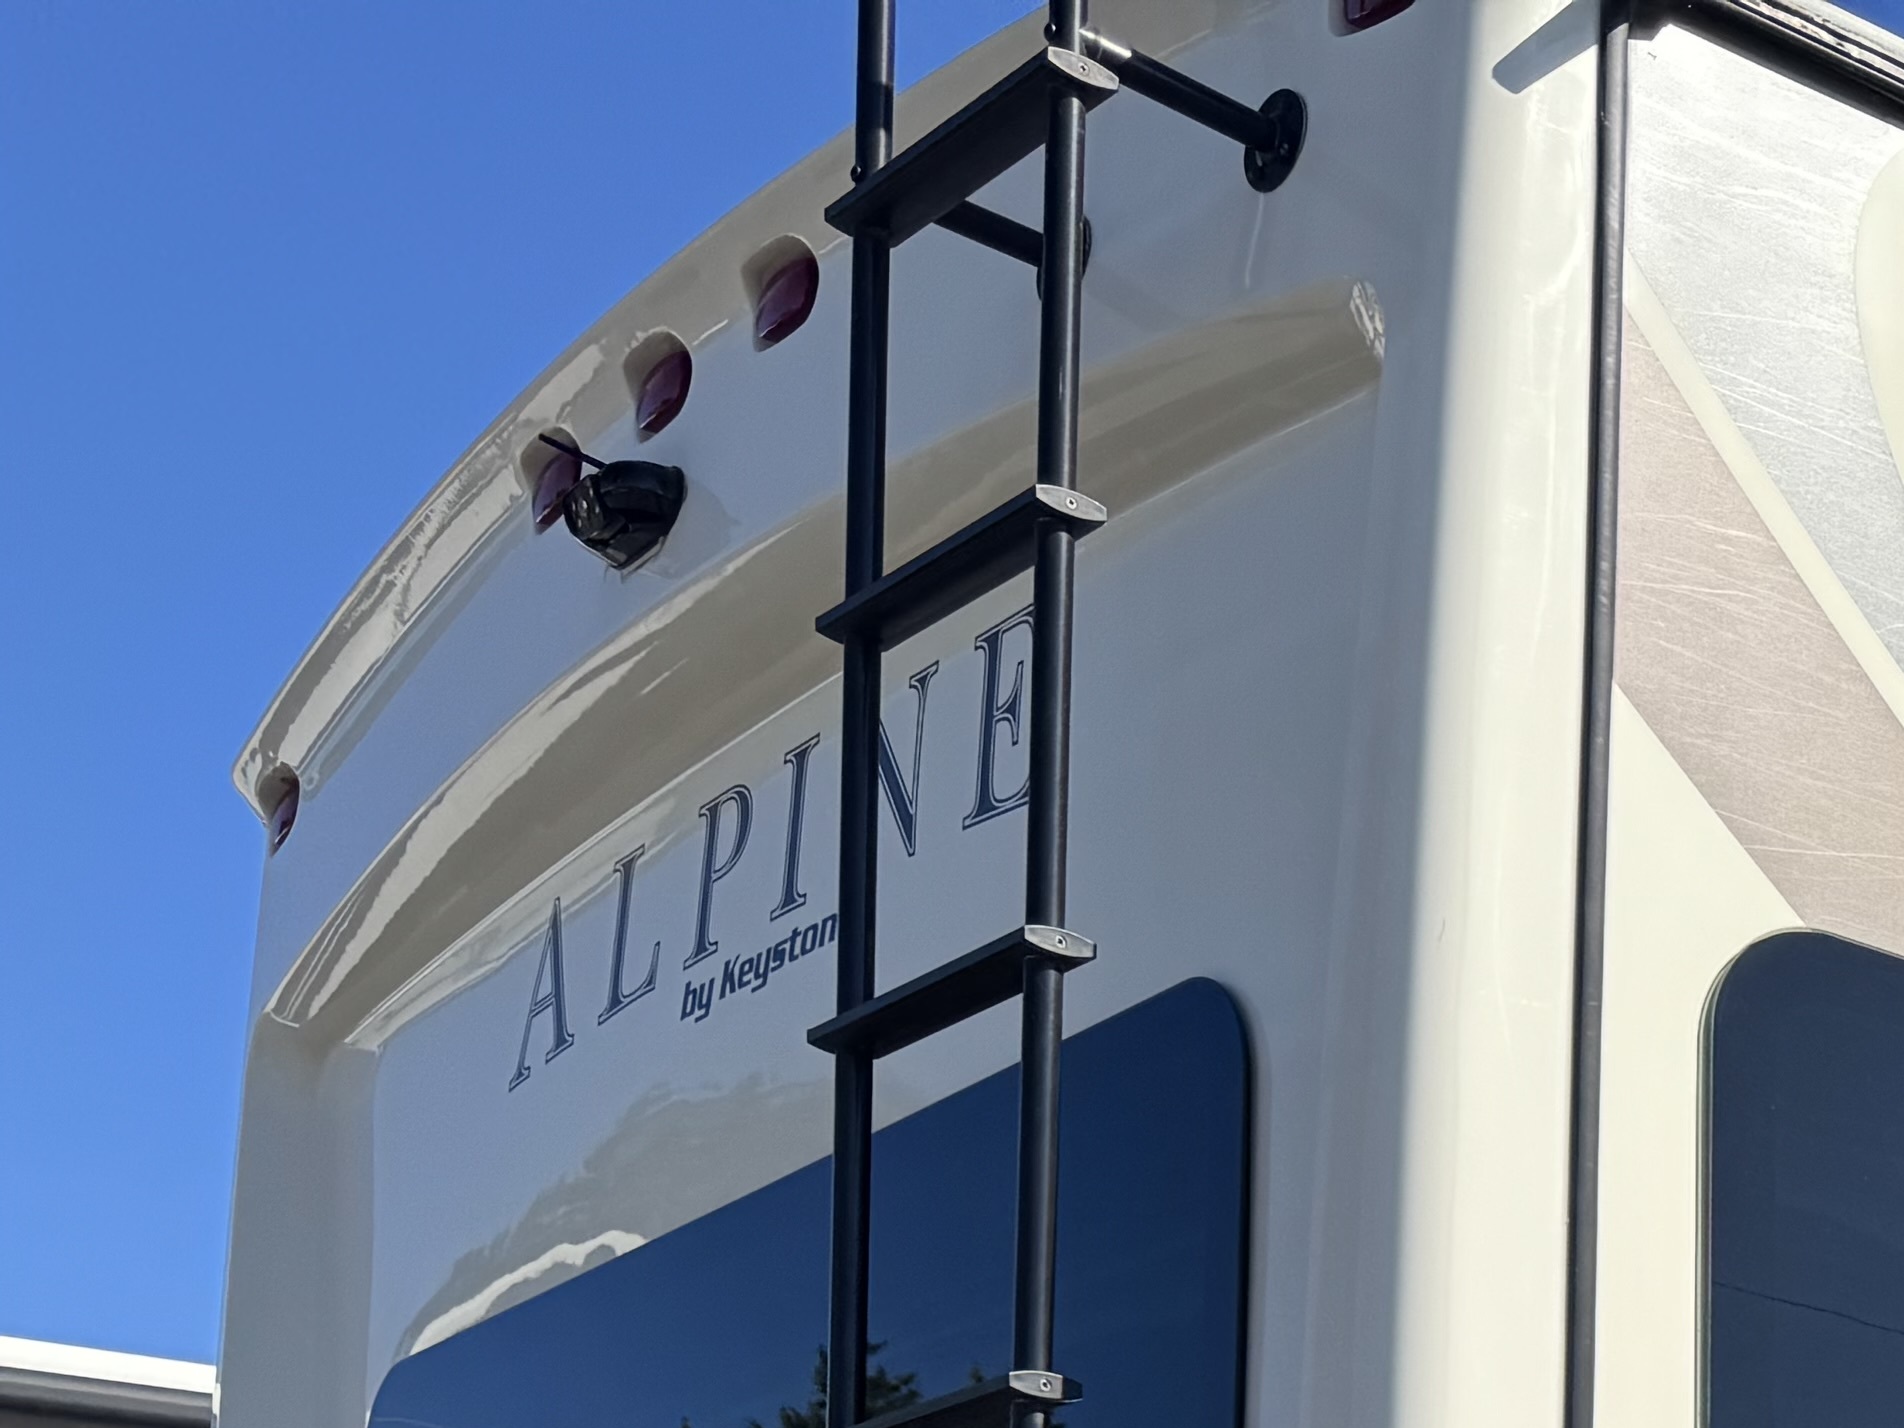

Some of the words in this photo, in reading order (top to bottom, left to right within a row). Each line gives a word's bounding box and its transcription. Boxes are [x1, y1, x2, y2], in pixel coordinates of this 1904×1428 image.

[508, 603, 1035, 1092] ALPINE
[680, 976, 716, 1024] by
[718, 912, 838, 1000] Keyston
